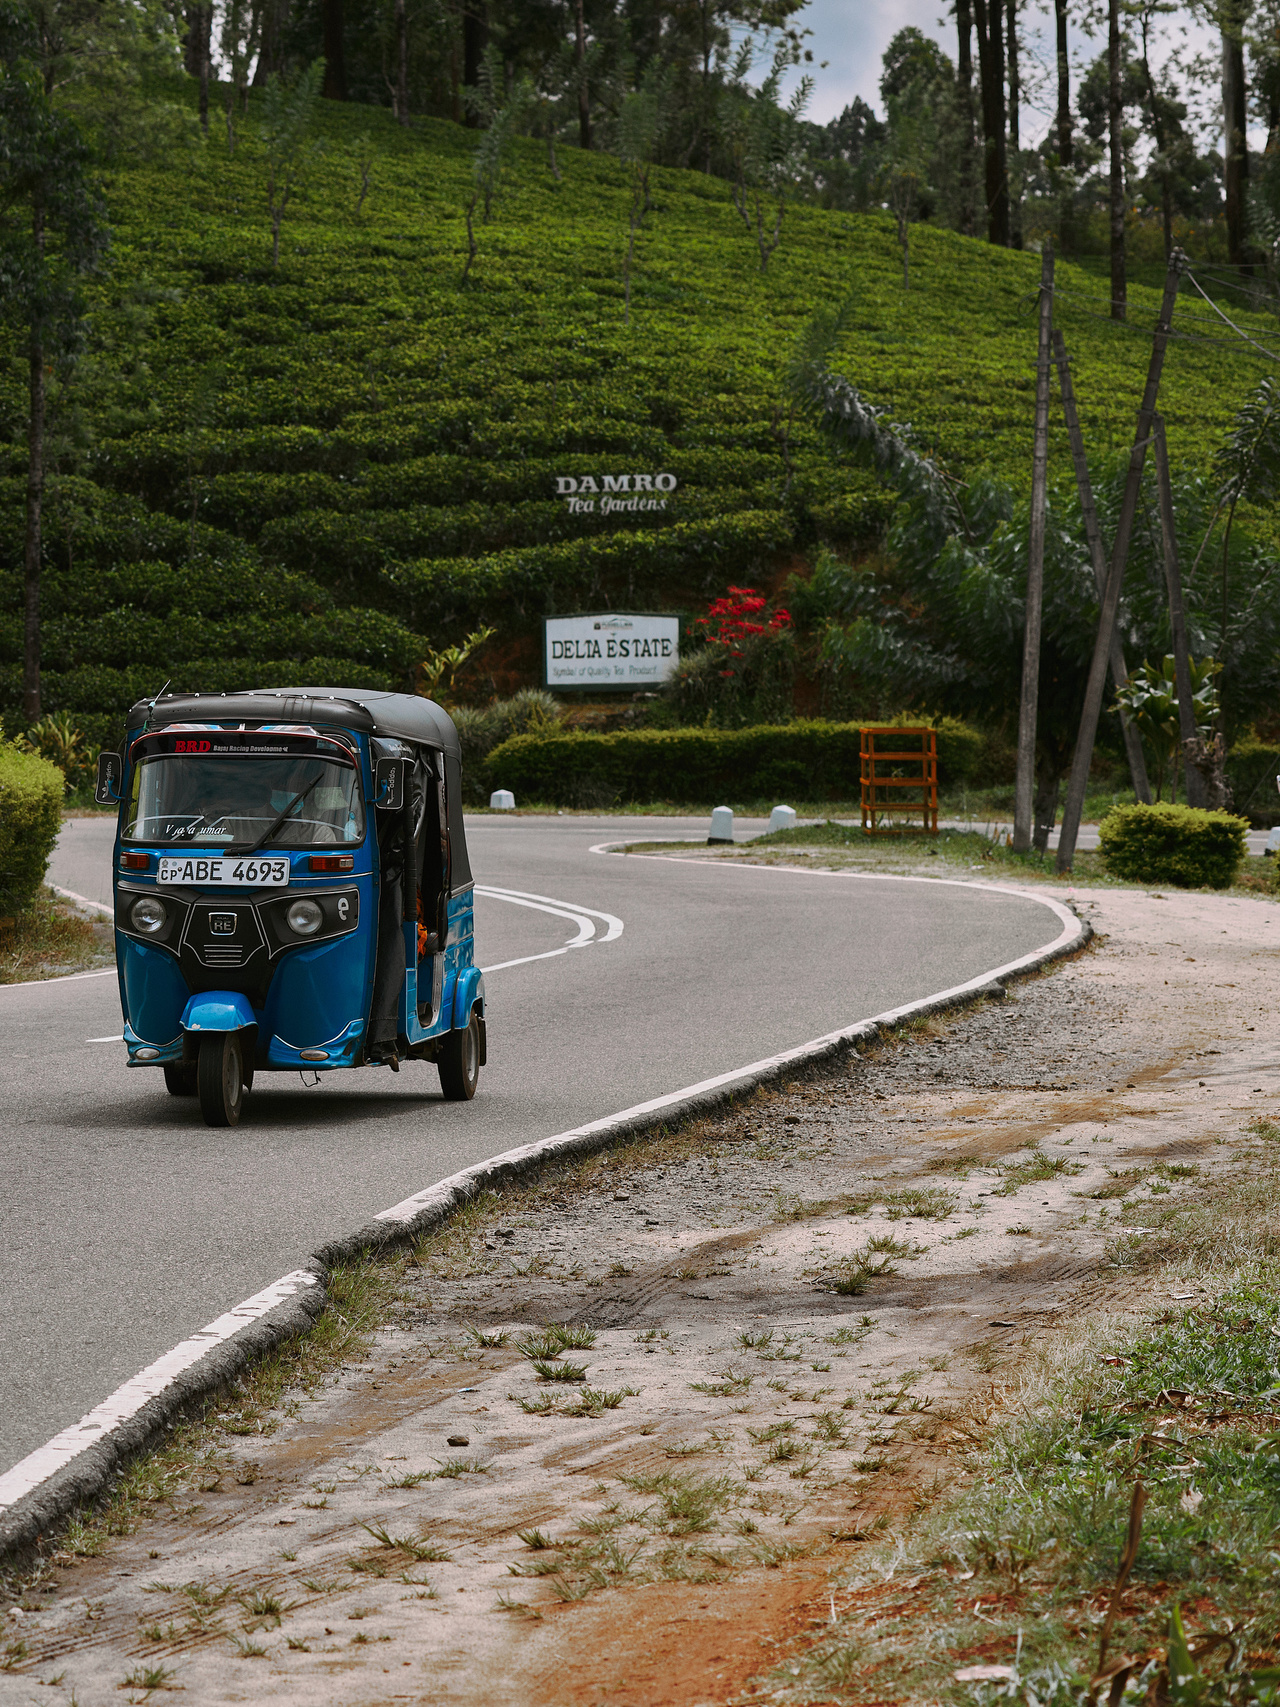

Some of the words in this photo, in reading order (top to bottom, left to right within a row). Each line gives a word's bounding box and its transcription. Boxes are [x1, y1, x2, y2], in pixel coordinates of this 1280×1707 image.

[555, 473, 678, 494] DAMRO
[566, 497, 595, 514] Tea
[599, 496, 668, 516] Gardens
[551, 639, 602, 659] DELTA
[606, 638, 673, 658] ESTATE
[578, 667, 587, 676] of
[175, 740, 211, 753] BRD
[160, 869, 177, 881] CP
[181, 860, 223, 881] ABE
[232, 861, 286, 882] 4693
[214, 920, 232, 931] RE
